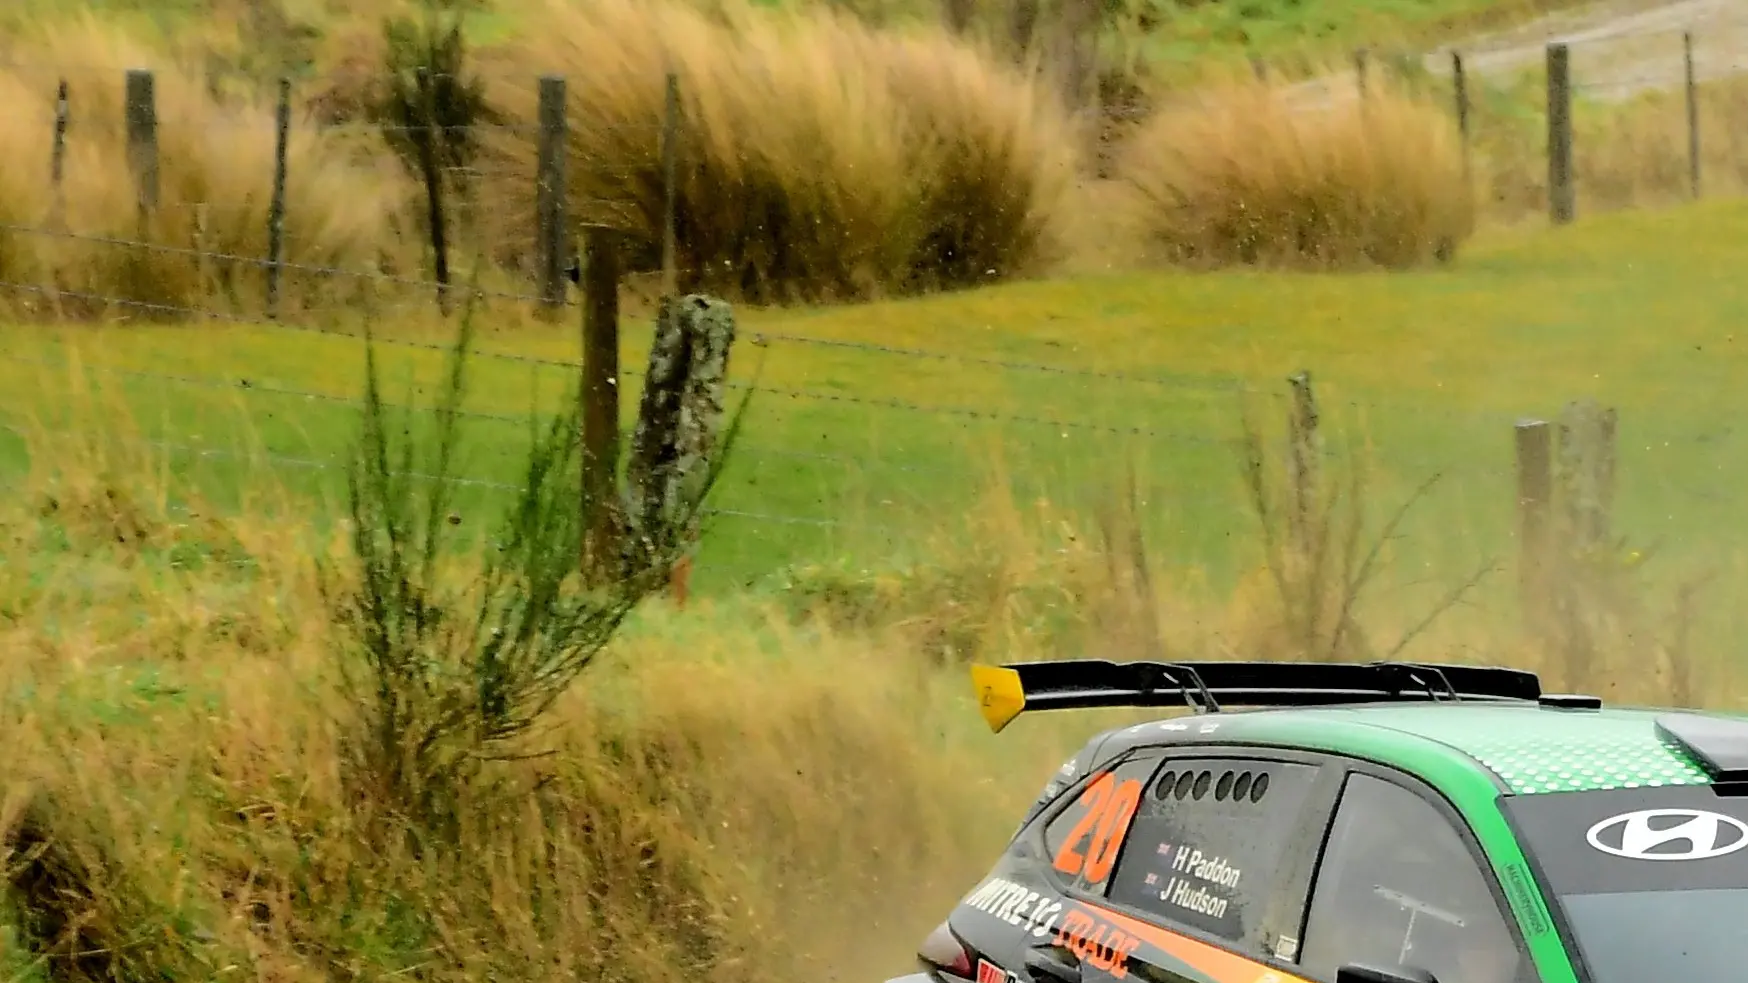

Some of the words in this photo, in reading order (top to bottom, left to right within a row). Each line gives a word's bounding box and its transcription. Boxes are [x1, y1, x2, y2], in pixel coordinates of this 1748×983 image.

[1053, 770, 1141, 883] 20
[1160, 877, 1176, 900] J
[1171, 879, 1229, 918] Hudson
[1171, 846, 1190, 871] H
[1185, 849, 1241, 888] Paddon
[966, 877, 1037, 925] MITRE
[1052, 909, 1141, 980] TRADE
